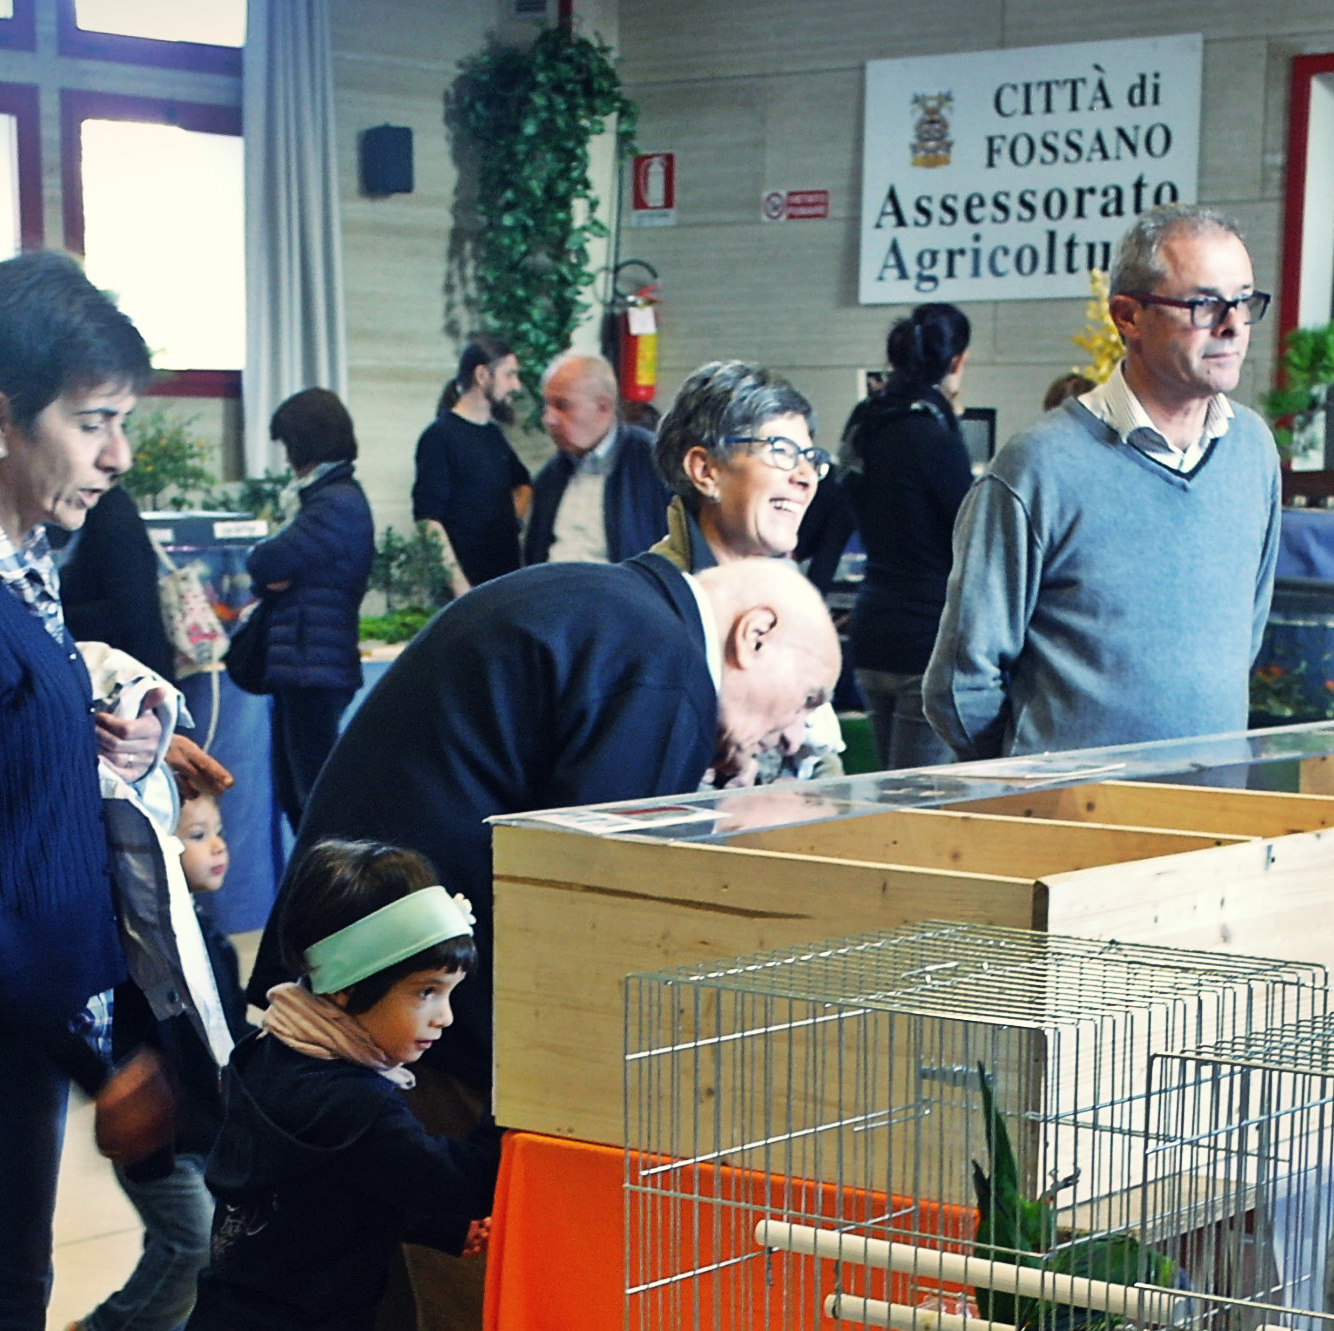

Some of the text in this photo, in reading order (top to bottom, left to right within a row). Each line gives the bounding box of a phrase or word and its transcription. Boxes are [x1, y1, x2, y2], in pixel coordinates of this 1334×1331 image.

[993, 63, 1161, 118] CITTÀ di
[985, 122, 1173, 169] FOSSANO
[873, 173, 1180, 229] Assessorato
[876, 229, 1112, 293] Agricoltu
